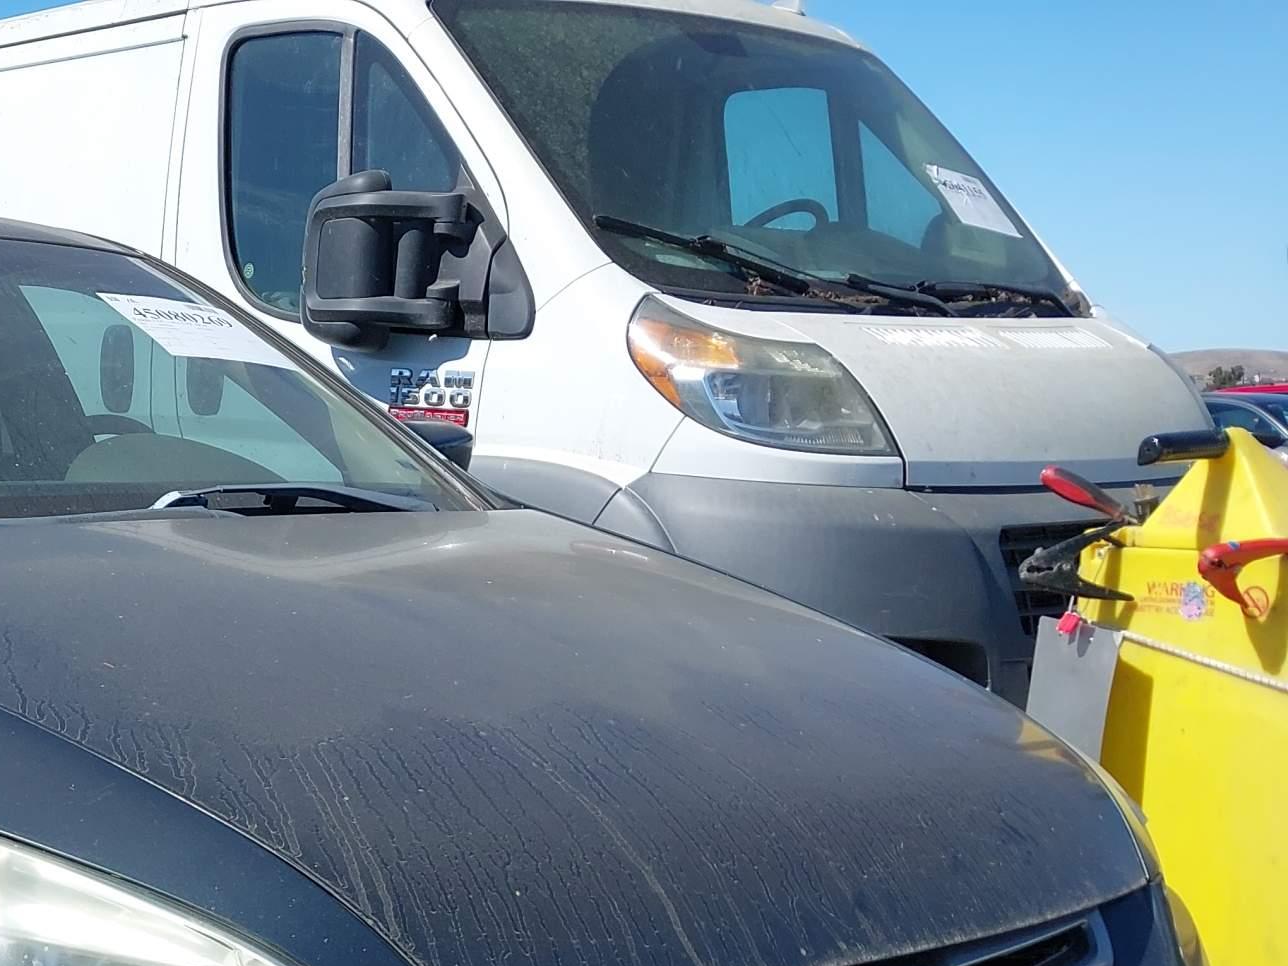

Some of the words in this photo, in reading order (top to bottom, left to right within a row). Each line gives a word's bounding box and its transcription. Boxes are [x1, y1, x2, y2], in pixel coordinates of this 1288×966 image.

[391, 368, 475, 388] RAM
[390, 387, 472, 408] 1500
[1146, 582, 1216, 598] WARG
